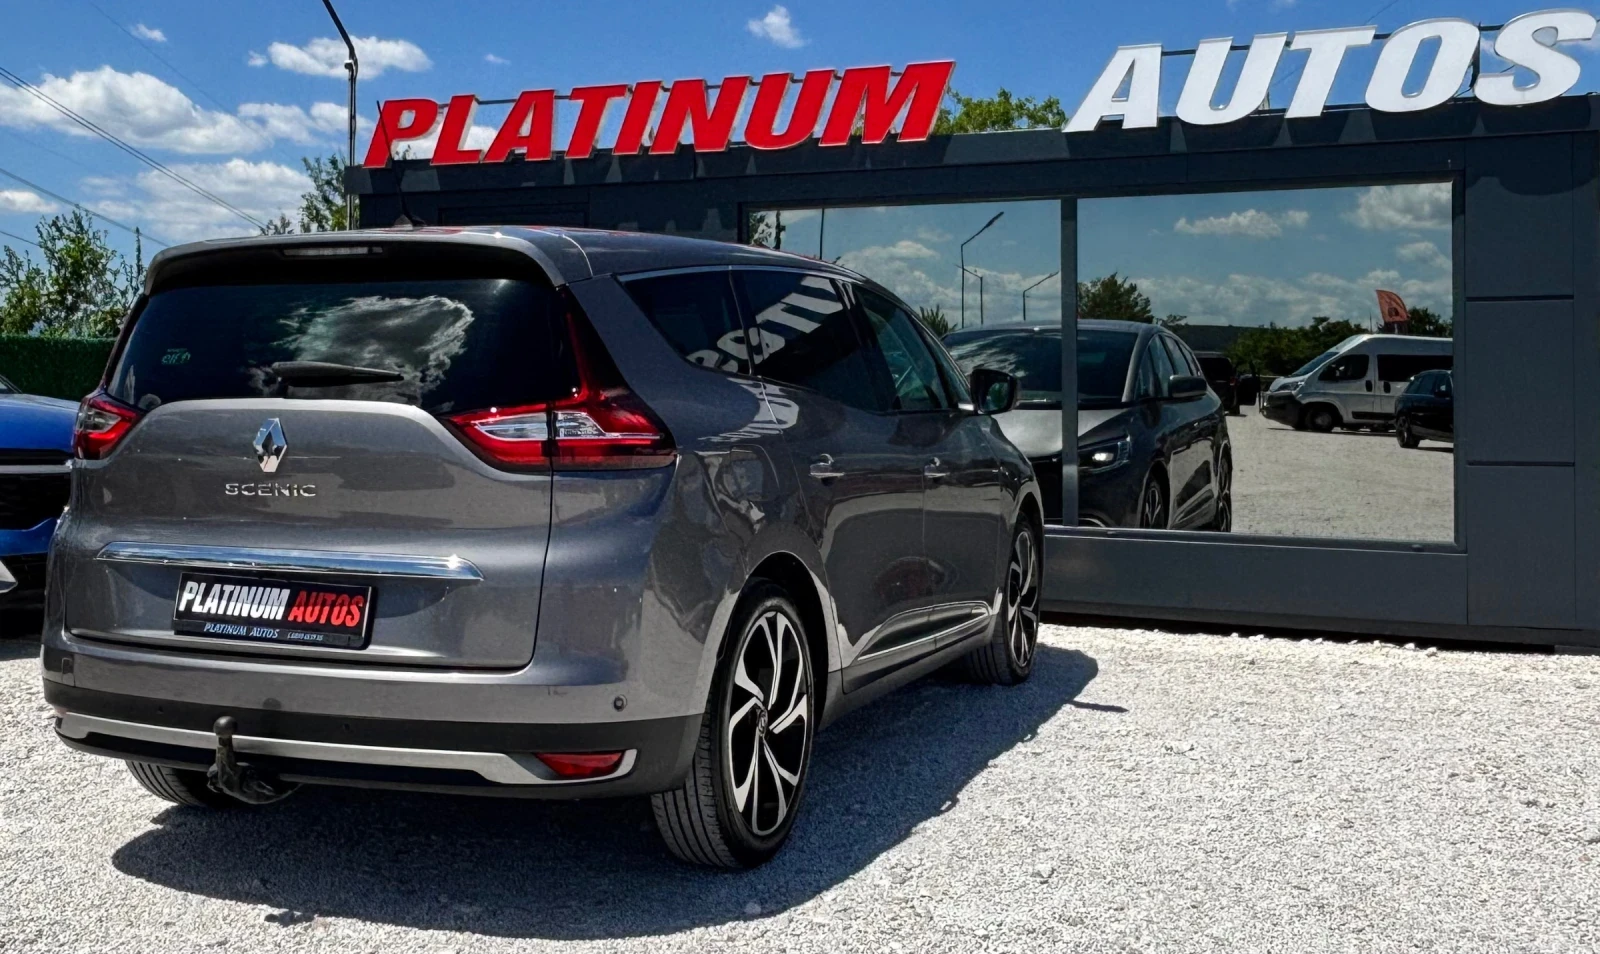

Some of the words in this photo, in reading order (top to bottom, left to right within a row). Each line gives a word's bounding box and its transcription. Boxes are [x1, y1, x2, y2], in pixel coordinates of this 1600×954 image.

[363, 60, 956, 169] PLATINUM
[1061, 8, 1598, 132] AUTOS
[224, 482, 317, 498] SCENIC
[178, 580, 290, 620] PLATINUM
[287, 590, 365, 627] AUTOS
[203, 622, 247, 636] PLATINUM
[249, 627, 280, 639] AUTOS
